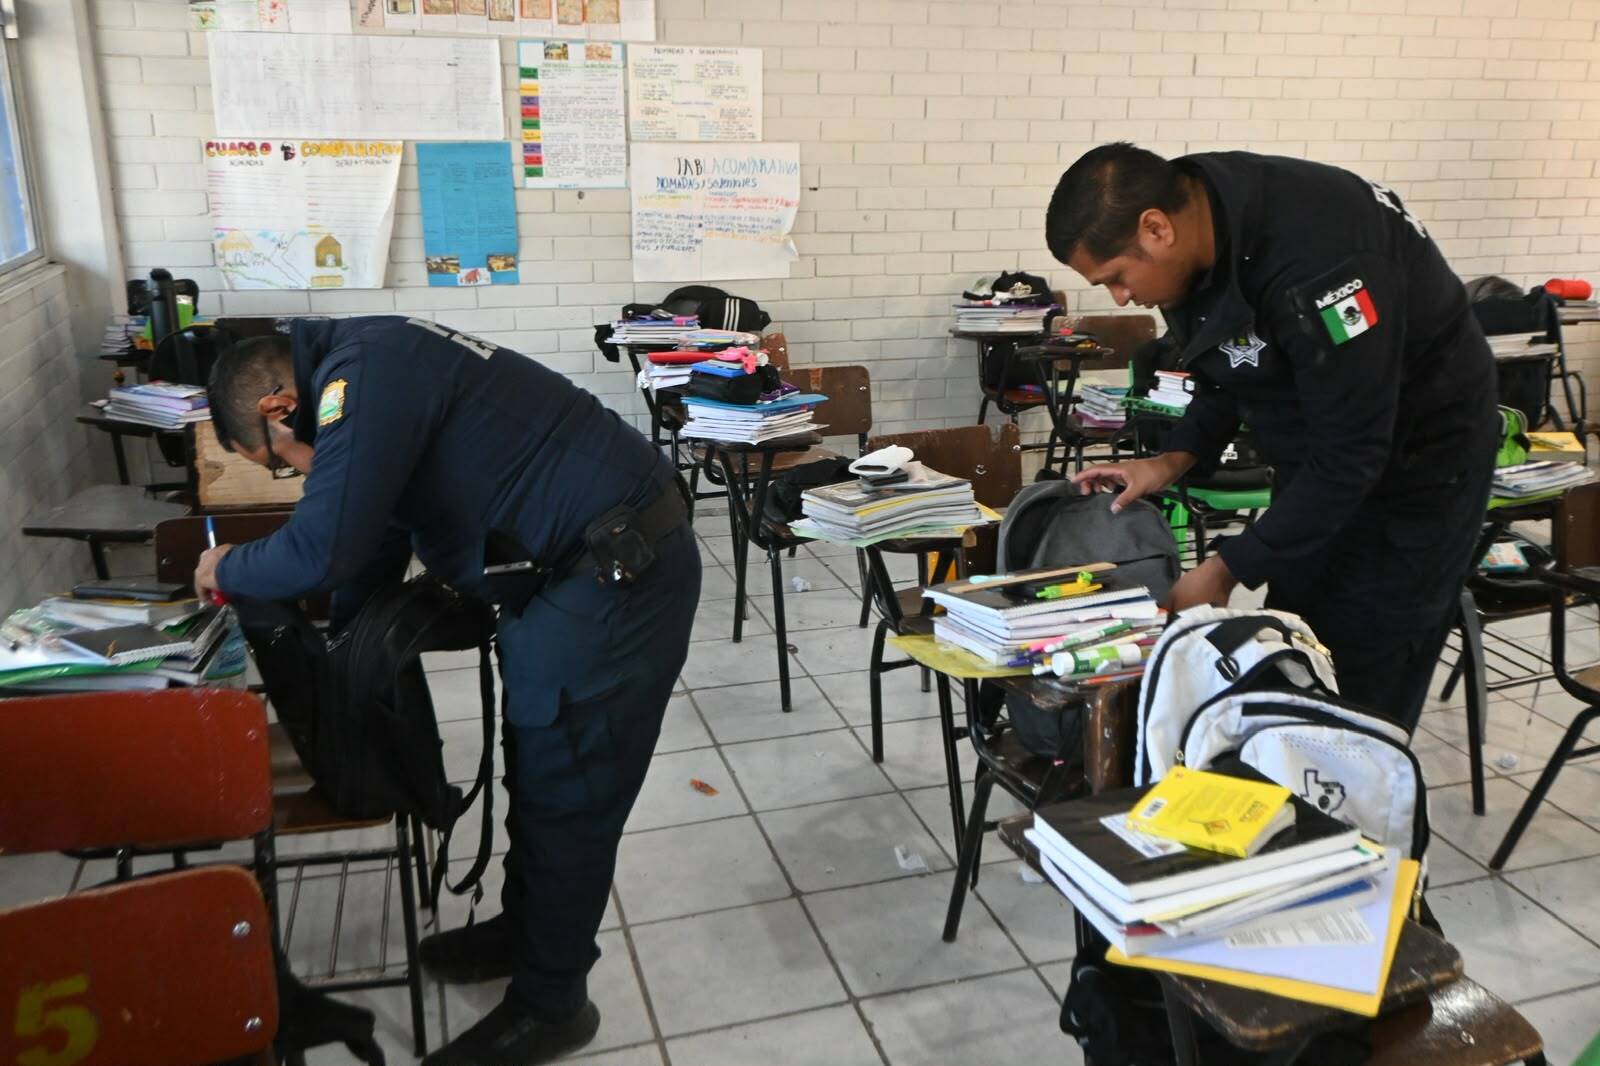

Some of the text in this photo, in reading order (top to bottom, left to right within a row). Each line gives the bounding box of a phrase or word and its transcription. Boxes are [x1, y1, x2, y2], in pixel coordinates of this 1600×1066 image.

[206, 141, 272, 157] CUADRO
[1315, 279, 1363, 309] MÉXICO
[14, 973, 97, 1066] 5
